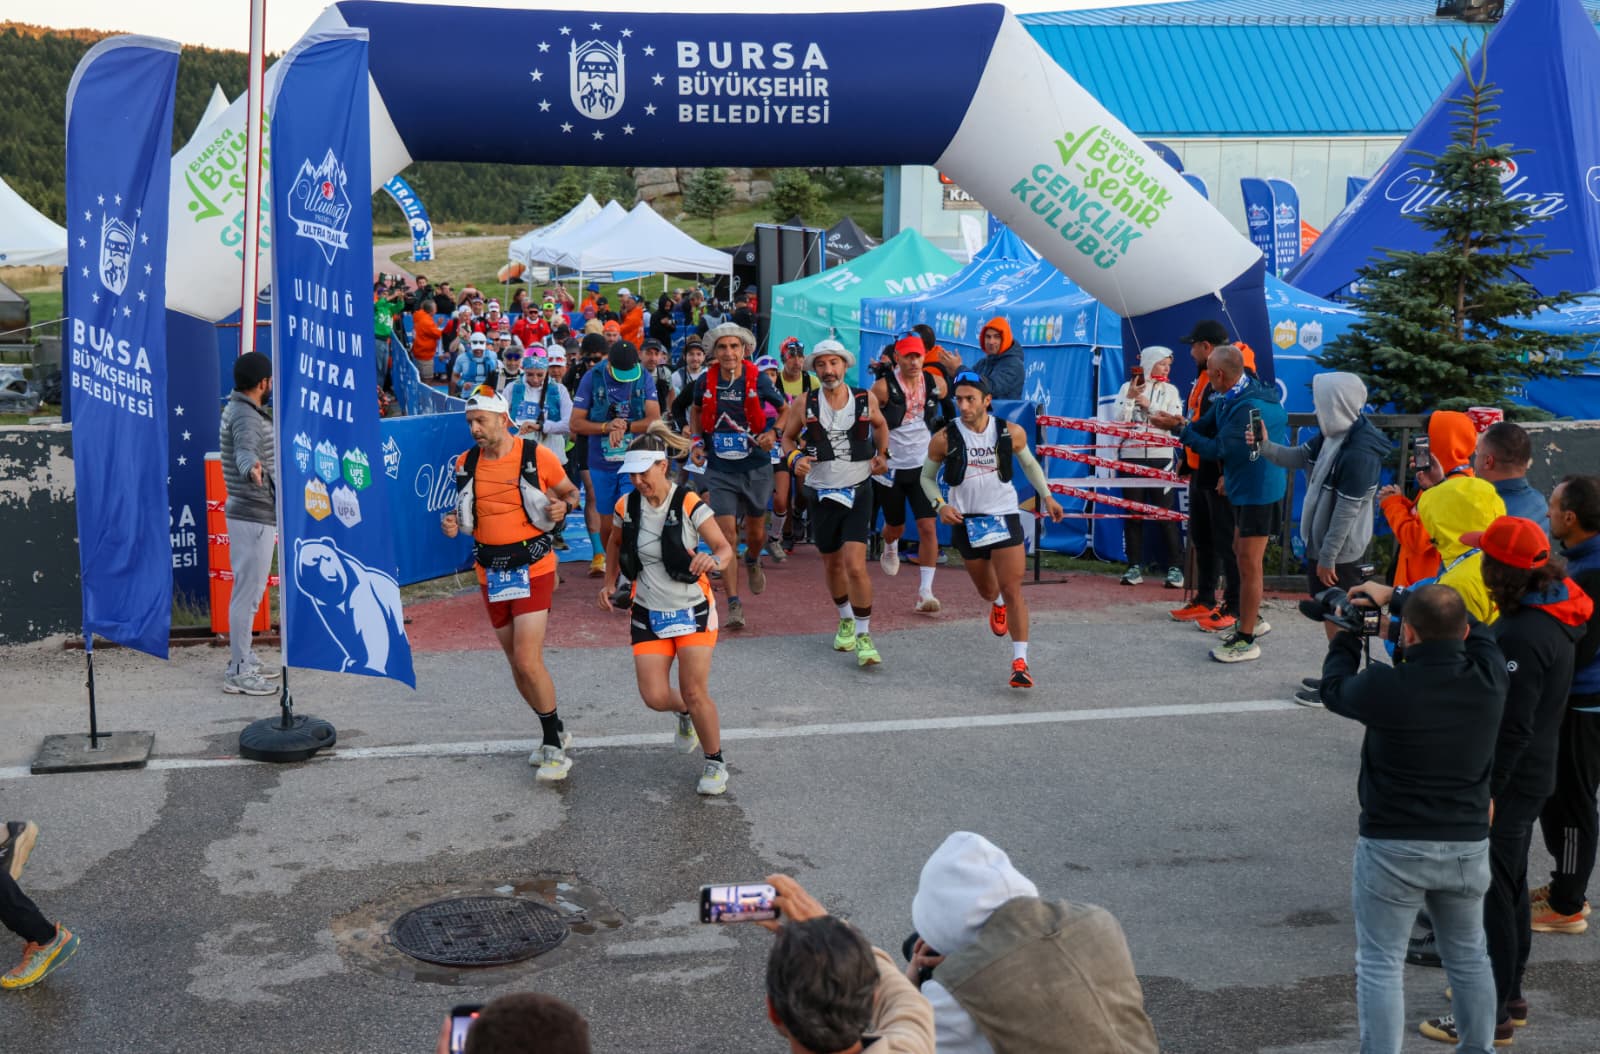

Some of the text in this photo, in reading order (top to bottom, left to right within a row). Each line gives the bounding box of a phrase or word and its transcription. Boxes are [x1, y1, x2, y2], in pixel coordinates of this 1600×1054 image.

[677, 41, 829, 70] BURSA
[678, 71, 829, 100] BÜYÜKŞEHİR
[678, 99, 829, 124] BELEDİYESİ
[302, 223, 326, 239] ULTRA
[1010, 177, 1119, 269] KULÜBÜ
[294, 277, 353, 317] ULUDAĞ
[73, 317, 152, 375] BURSA
[288, 314, 362, 358] PREMIUM
[72, 347, 153, 397] BÜYÜKŞEHİR
[299, 352, 355, 390] ULTRA
[71, 370, 154, 419] BELEDİYESİ
[300, 386, 354, 423] TRAIL
[723, 437, 734, 447] 63
[499, 570, 511, 583] 96
